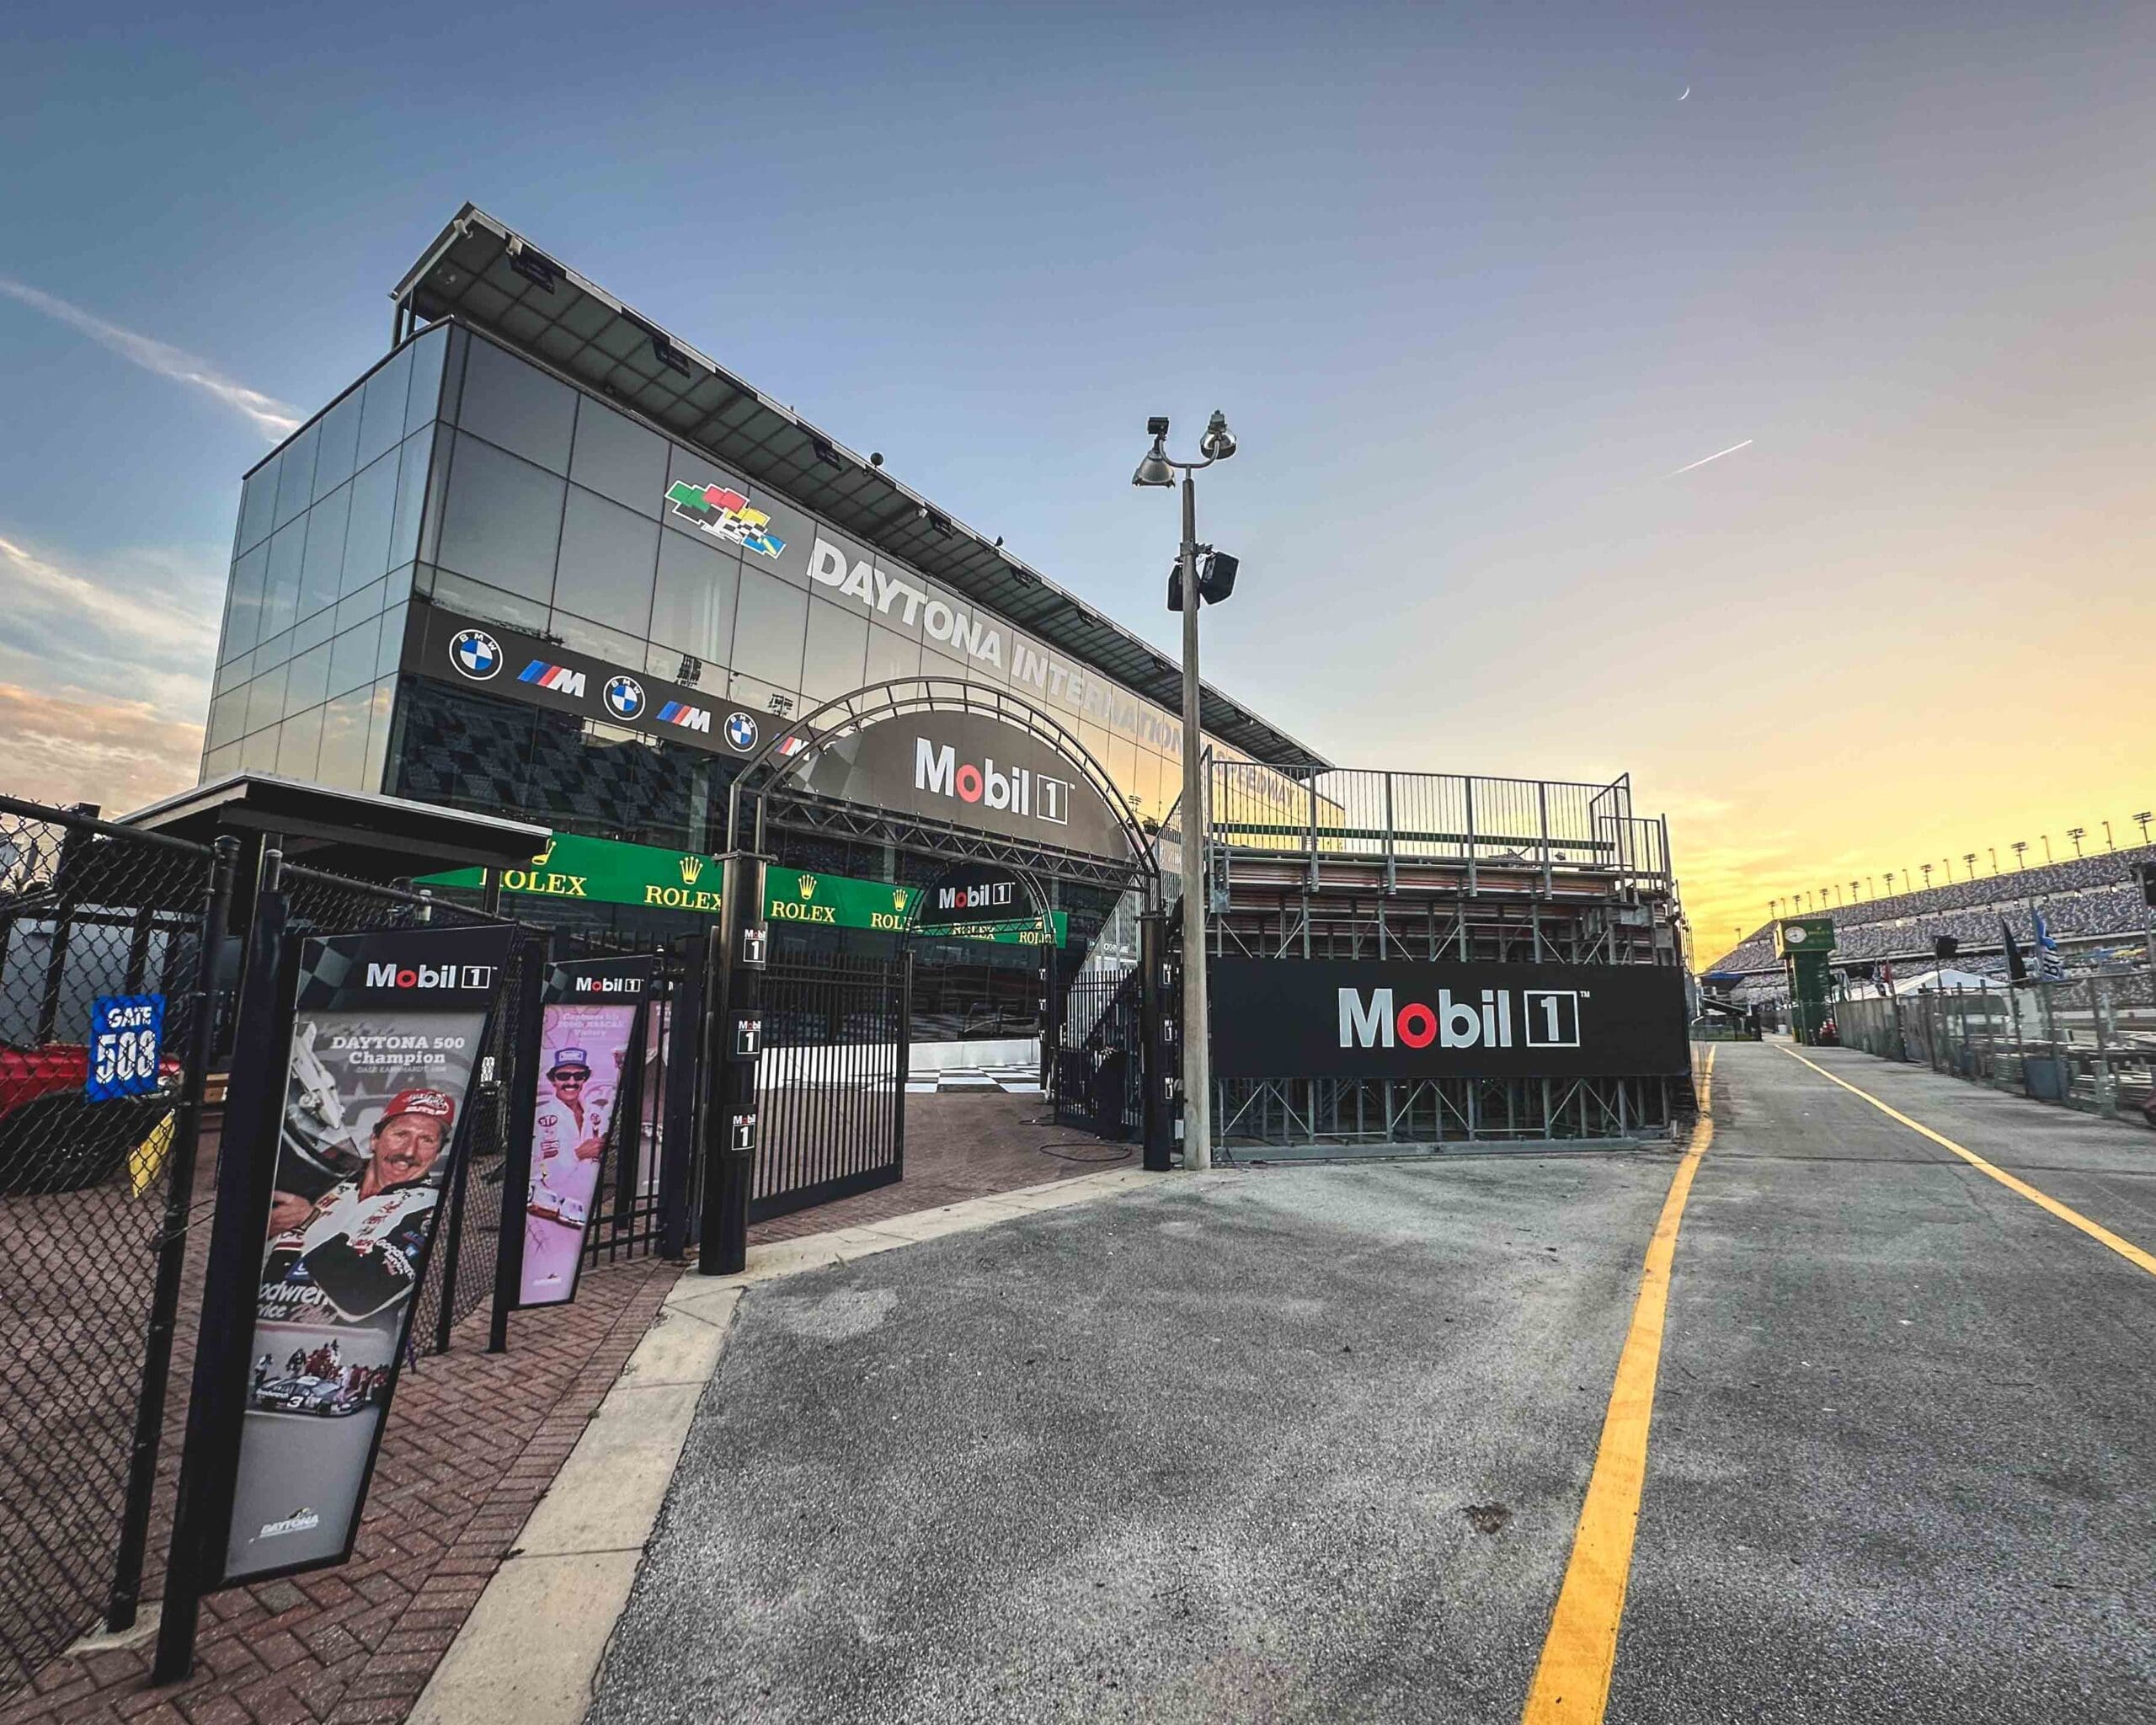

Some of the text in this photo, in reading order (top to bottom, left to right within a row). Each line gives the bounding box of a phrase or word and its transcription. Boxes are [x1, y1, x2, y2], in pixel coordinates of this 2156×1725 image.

[806, 537, 1002, 670] DAYTONA
[1011, 643, 1207, 756] INTERNATION
[915, 737, 1029, 816] Mobil
[938, 884, 990, 910] Mobil
[771, 900, 836, 924] ROLEX
[366, 963, 456, 989] Mobil
[575, 977, 623, 992] Mobil
[107, 1006, 152, 1028] GATE
[1337, 987, 1513, 1049] Mobil
[330, 1036, 465, 1049] DAYTONA 500
[95, 1030, 156, 1084] 508
[349, 1051, 446, 1065] Champion
[286, 1396, 305, 1408] 3
